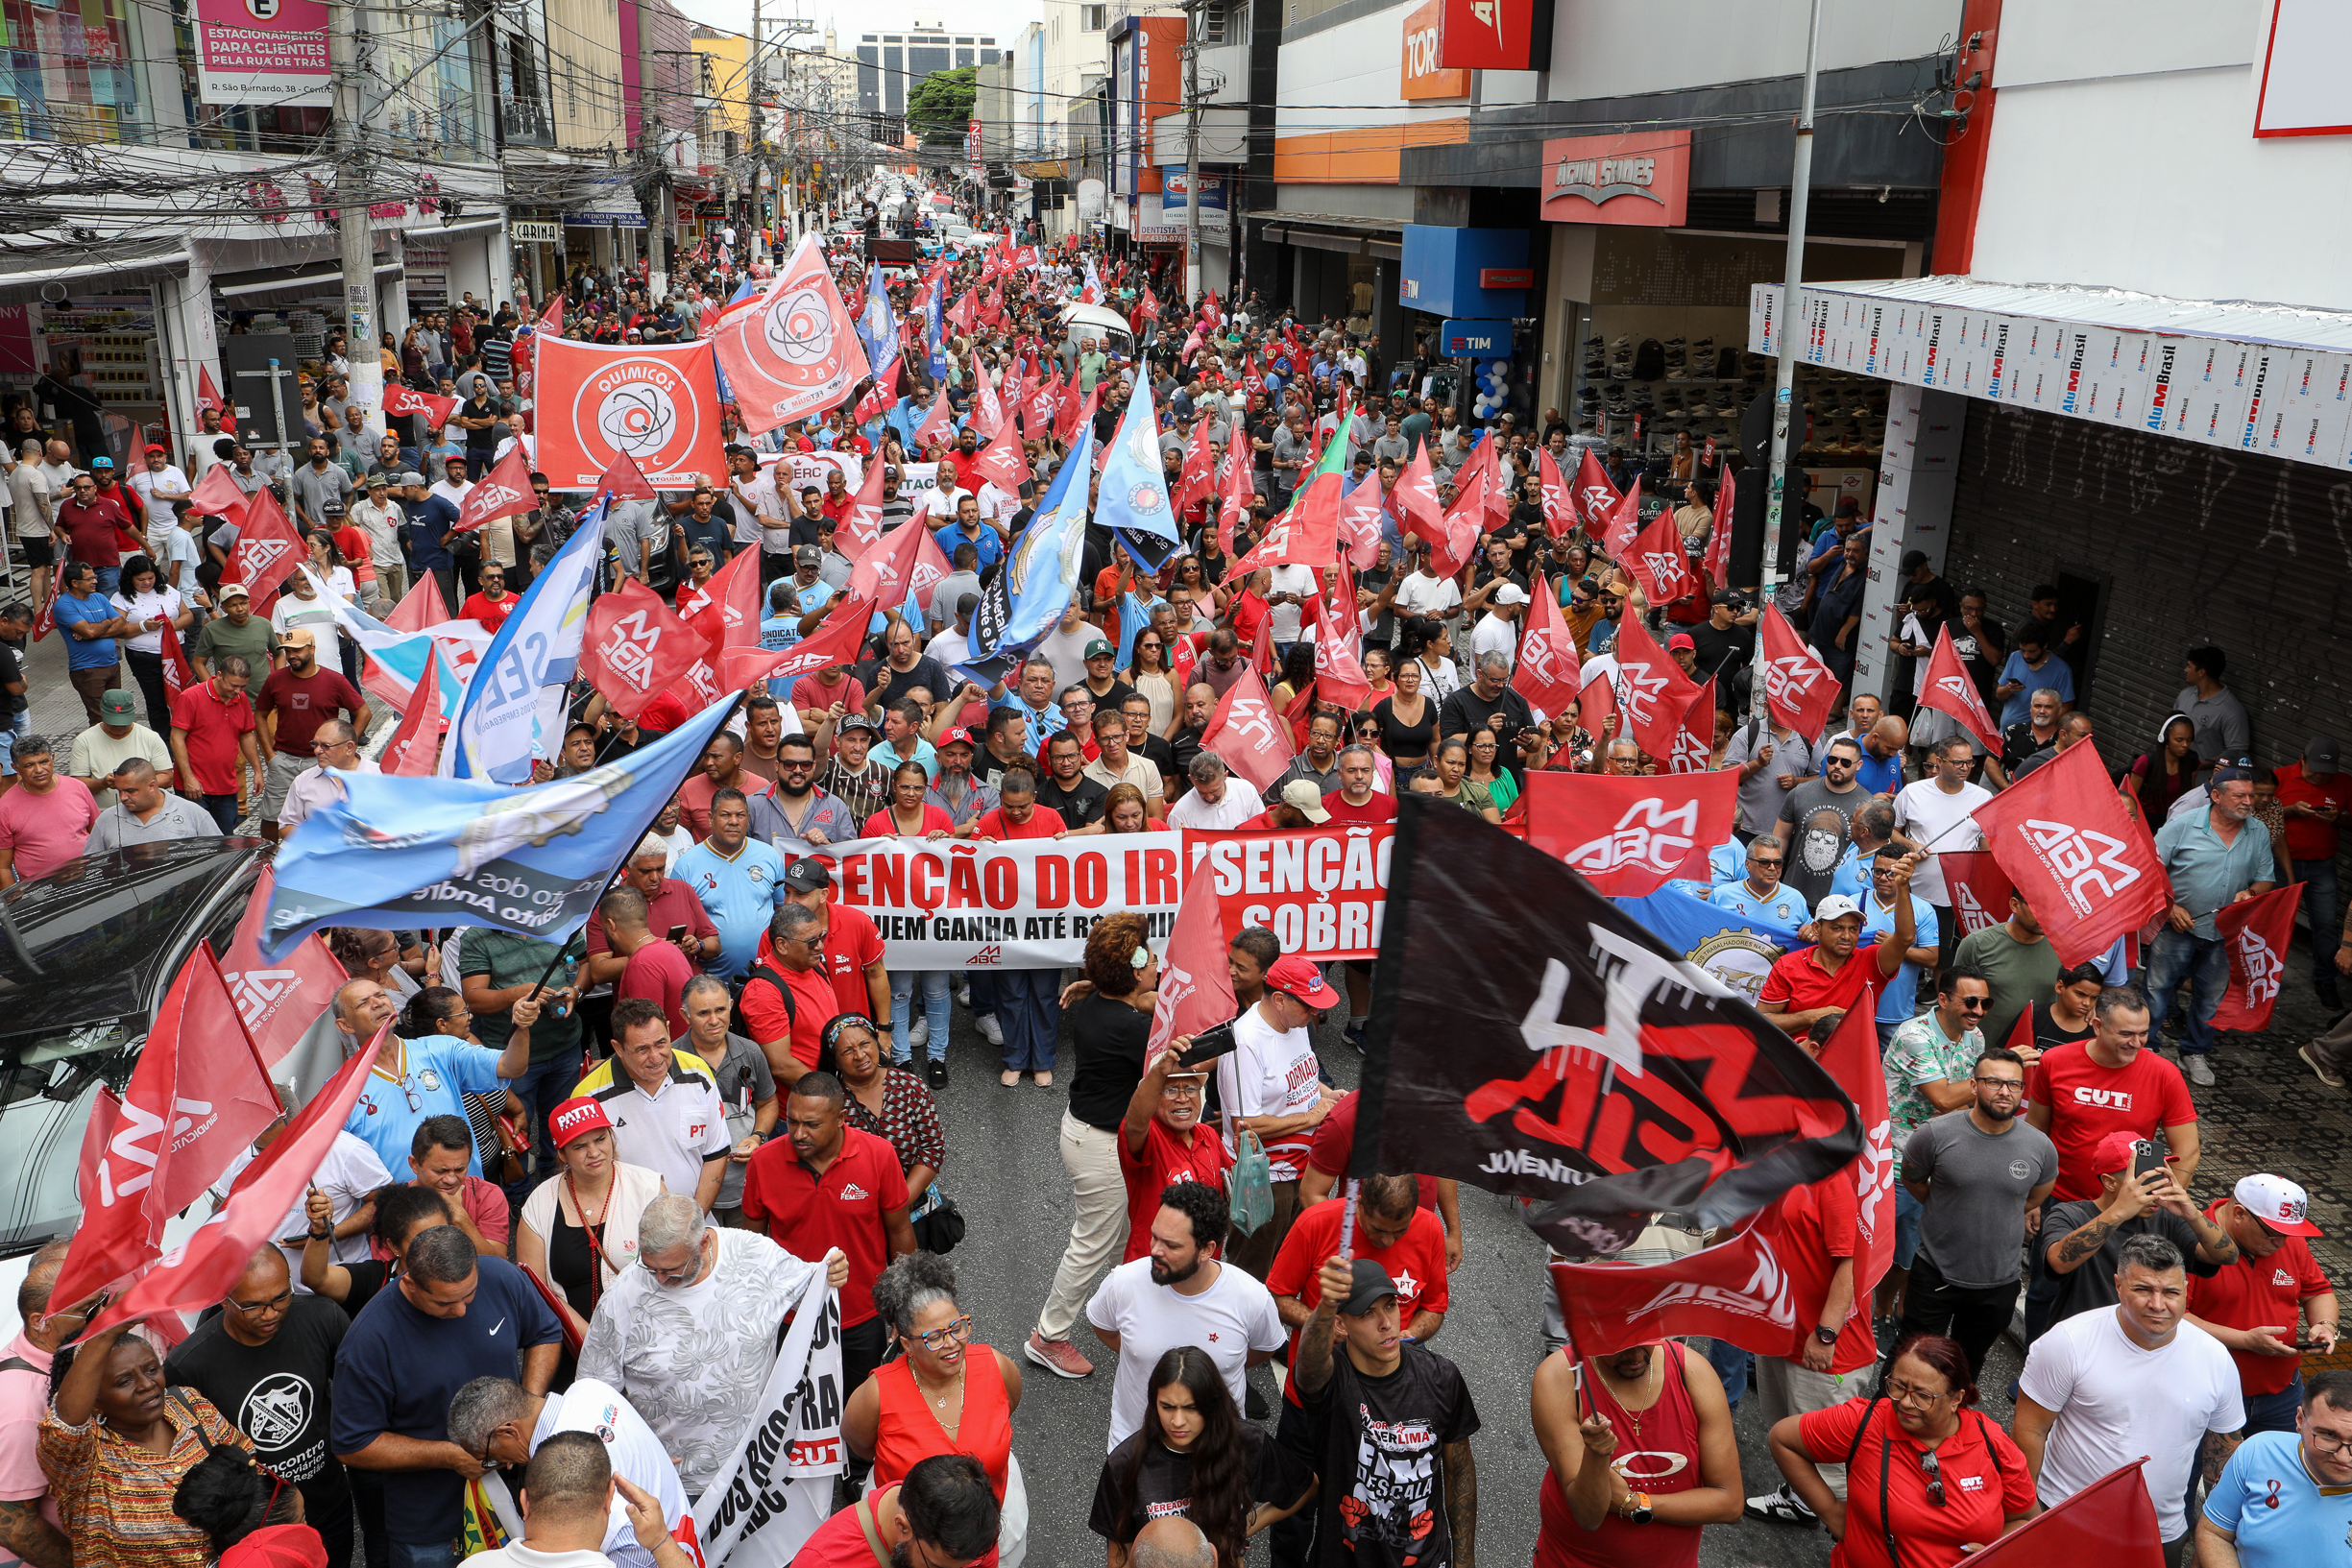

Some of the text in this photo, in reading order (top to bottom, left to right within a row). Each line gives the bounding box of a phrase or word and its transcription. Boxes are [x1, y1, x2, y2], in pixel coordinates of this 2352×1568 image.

[207, 28, 325, 41] ESTACIONAMENTO
[209, 41, 327, 56] PARA CLIENTES
[211, 55, 327, 67] PELA RUA DE TRÁS
[240, 84, 284, 94] Bernardo,
[303, 85, 333, 94] Centro
[1139, 31, 1150, 169] DENTISTA
[1555, 156, 1655, 187] ÁGUIA SHOES
[1169, 176, 1221, 189] Plna
[517, 224, 555, 239] CARINA
[1141, 226, 1177, 234] DENTISTA
[1407, 279, 1418, 299] TIM
[0, 306, 20, 319] NY
[1761, 293, 1774, 353] AluMBrasil
[1814, 300, 1829, 363] AluMBrasil
[1467, 337, 1491, 350] TIM
[1865, 306, 1883, 374] AluMBrasil
[1923, 314, 1943, 385] AluMBrasil
[1988, 324, 2010, 398] AluMBrasil
[597, 365, 676, 393] QUÍMICOS
[2062, 333, 2088, 414] AluMBrasil
[2146, 345, 2177, 431] AluMBrasil
[794, 467, 822, 479] ERC
[1637, 508, 1662, 517] Guima
[1155, 537, 1169, 550] de
[1564, 827, 1695, 869] ABC
[2017, 823, 2042, 856] SINDICATO
[2025, 818, 2115, 915] ABC
[784, 844, 1178, 920] SENÇÃO DO IR
[934, 915, 1020, 942] GANHA
[1025, 911, 1067, 941] ATÉ
[1704, 939, 1753, 957] TRABALHADORES
[1753, 943, 1765, 953] NAS
[965, 954, 1002, 964] ABC
[2242, 925, 2267, 1005] ABC
[1286, 1088, 1303, 1102] SEM
[2074, 1086, 2128, 1107] CUT
[556, 1103, 597, 1128] PATTY
[690, 1123, 707, 1138] PT
[1172, 1170, 1194, 1186] 13
[1399, 1280, 1418, 1290] PT
[1397, 1430, 1430, 1445] LIMA
[788, 1442, 842, 1468] CUT
[279, 1451, 326, 1480] doviários
[293, 1460, 326, 1484] Região
[1959, 1475, 1982, 1487] CUT
